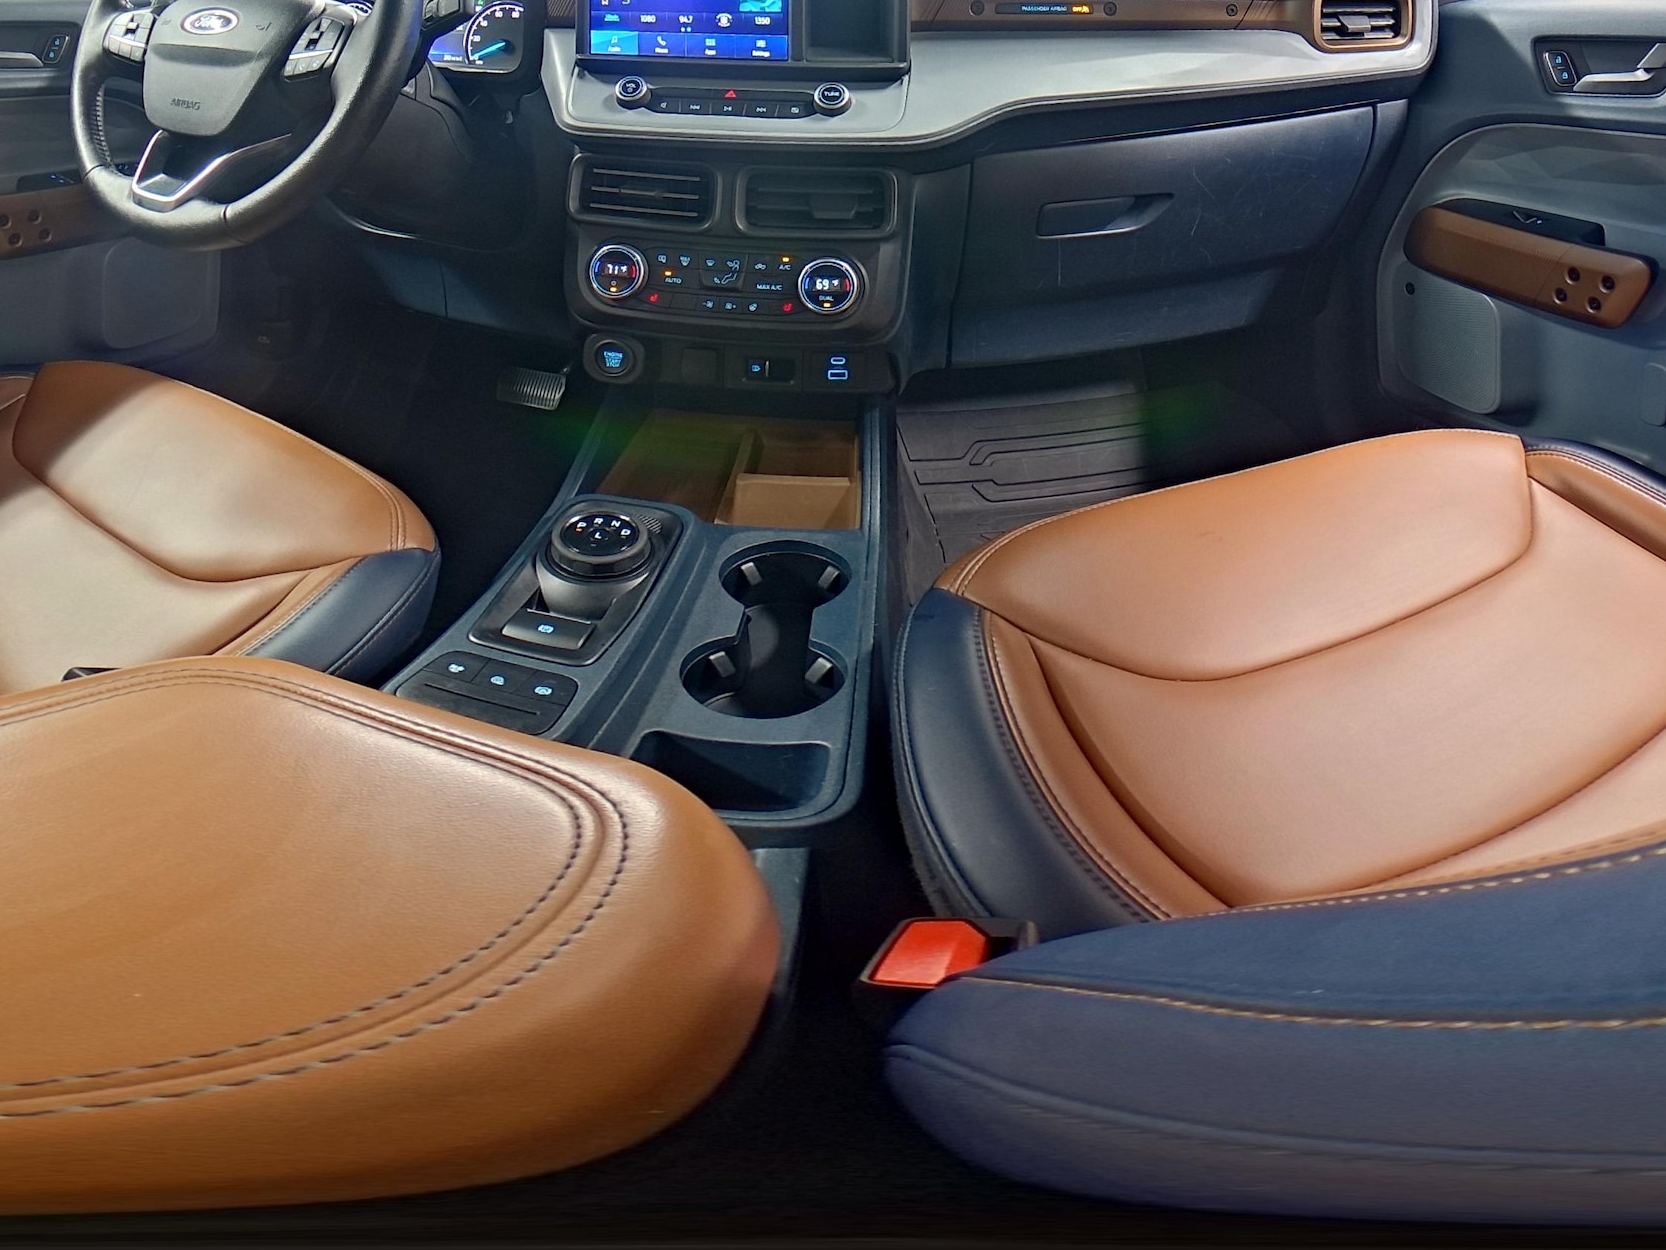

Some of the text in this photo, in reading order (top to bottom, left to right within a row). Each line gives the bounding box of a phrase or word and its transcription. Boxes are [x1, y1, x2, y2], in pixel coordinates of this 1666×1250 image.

[640, 14, 656, 23] 1080
[678, 15, 693, 24] 94.7
[754, 16, 771, 25] 1350
[171, 98, 201, 111] AIRBAG
[593, 517, 604, 525] R
[611, 520, 622, 528] N
[594, 531, 602, 539] L
[620, 528, 631, 536] D
